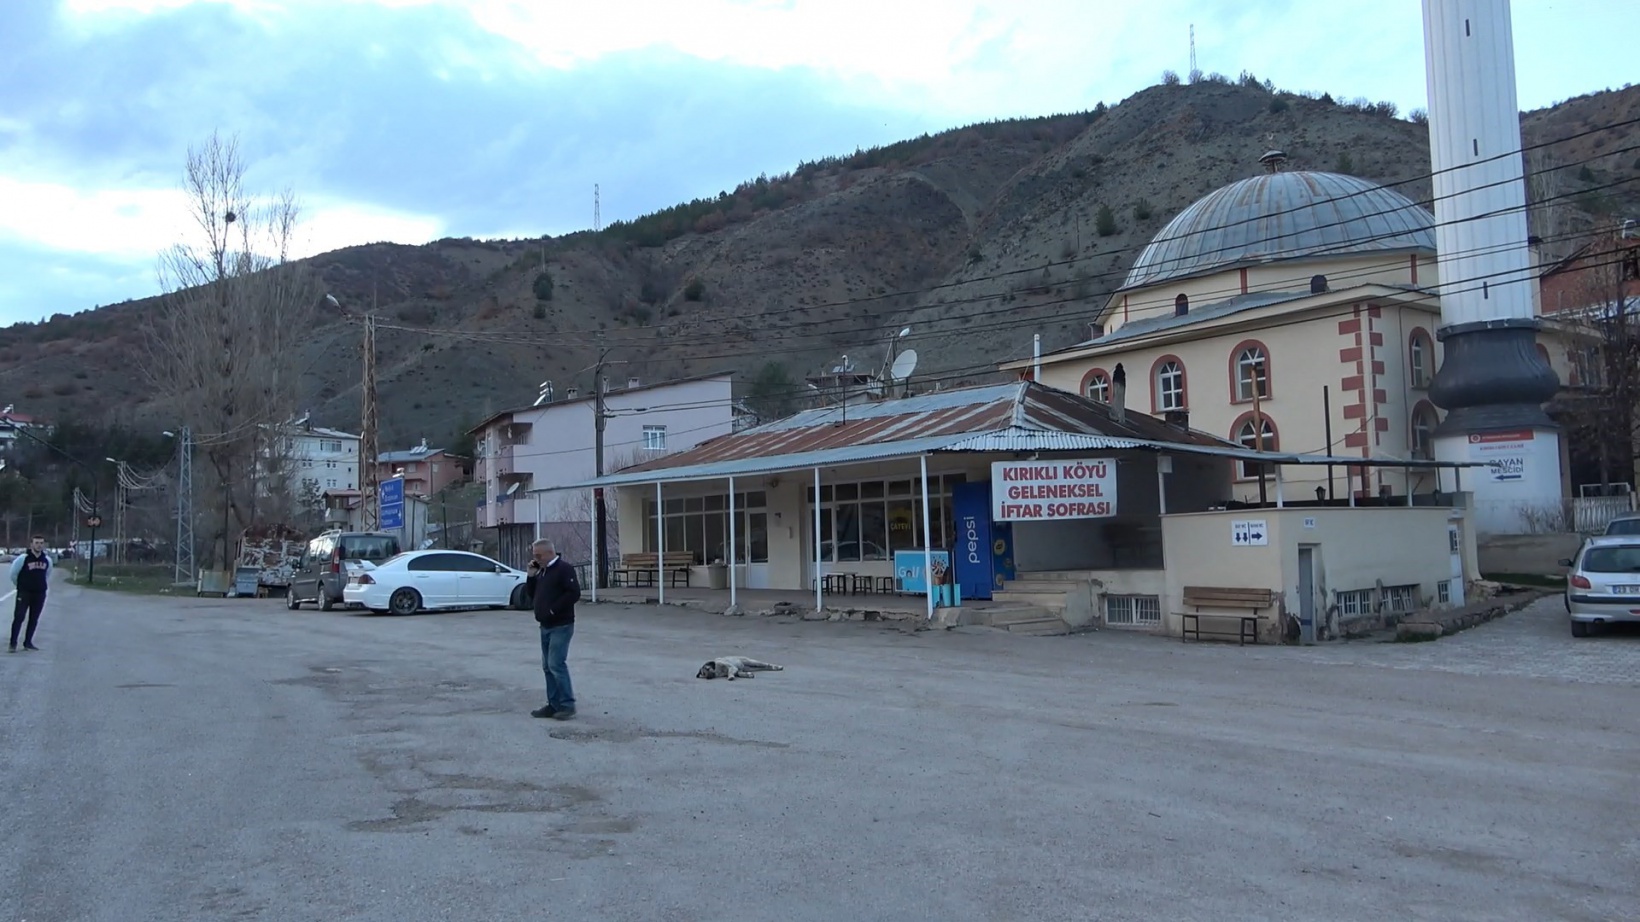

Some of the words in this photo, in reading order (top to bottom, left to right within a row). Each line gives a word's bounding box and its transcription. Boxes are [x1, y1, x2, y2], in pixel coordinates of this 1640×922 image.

[1003, 466, 1058, 481] KIRIKLI
[1063, 461, 1107, 479] KÖYÜ
[1008, 484, 1103, 500] GELENEKSEL
[1001, 501, 1042, 519] İFTAR
[1047, 502, 1110, 518] SOFRASI
[963, 516, 980, 564] pepsi
